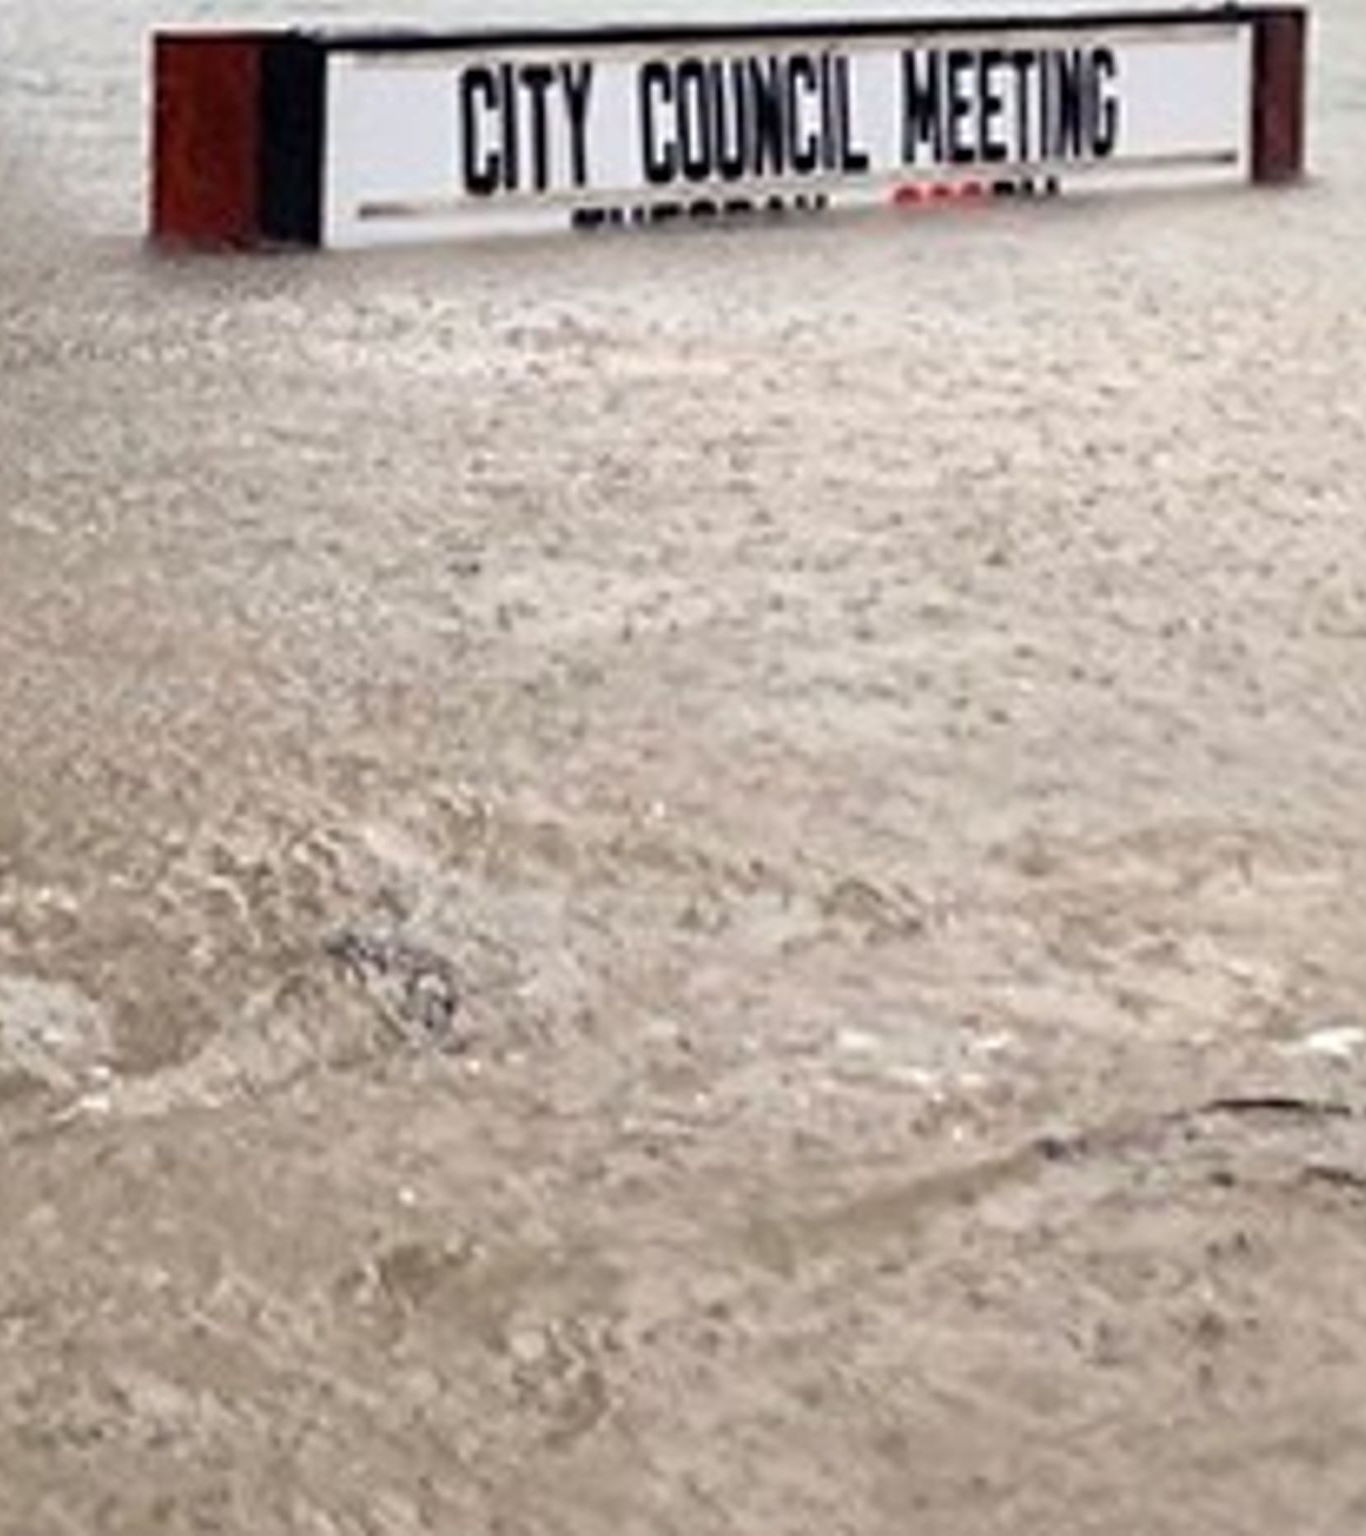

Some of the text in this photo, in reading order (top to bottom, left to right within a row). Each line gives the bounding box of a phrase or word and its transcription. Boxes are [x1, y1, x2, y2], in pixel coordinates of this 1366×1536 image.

[460, 47, 1118, 196] CITY COUNCIL MEETING
